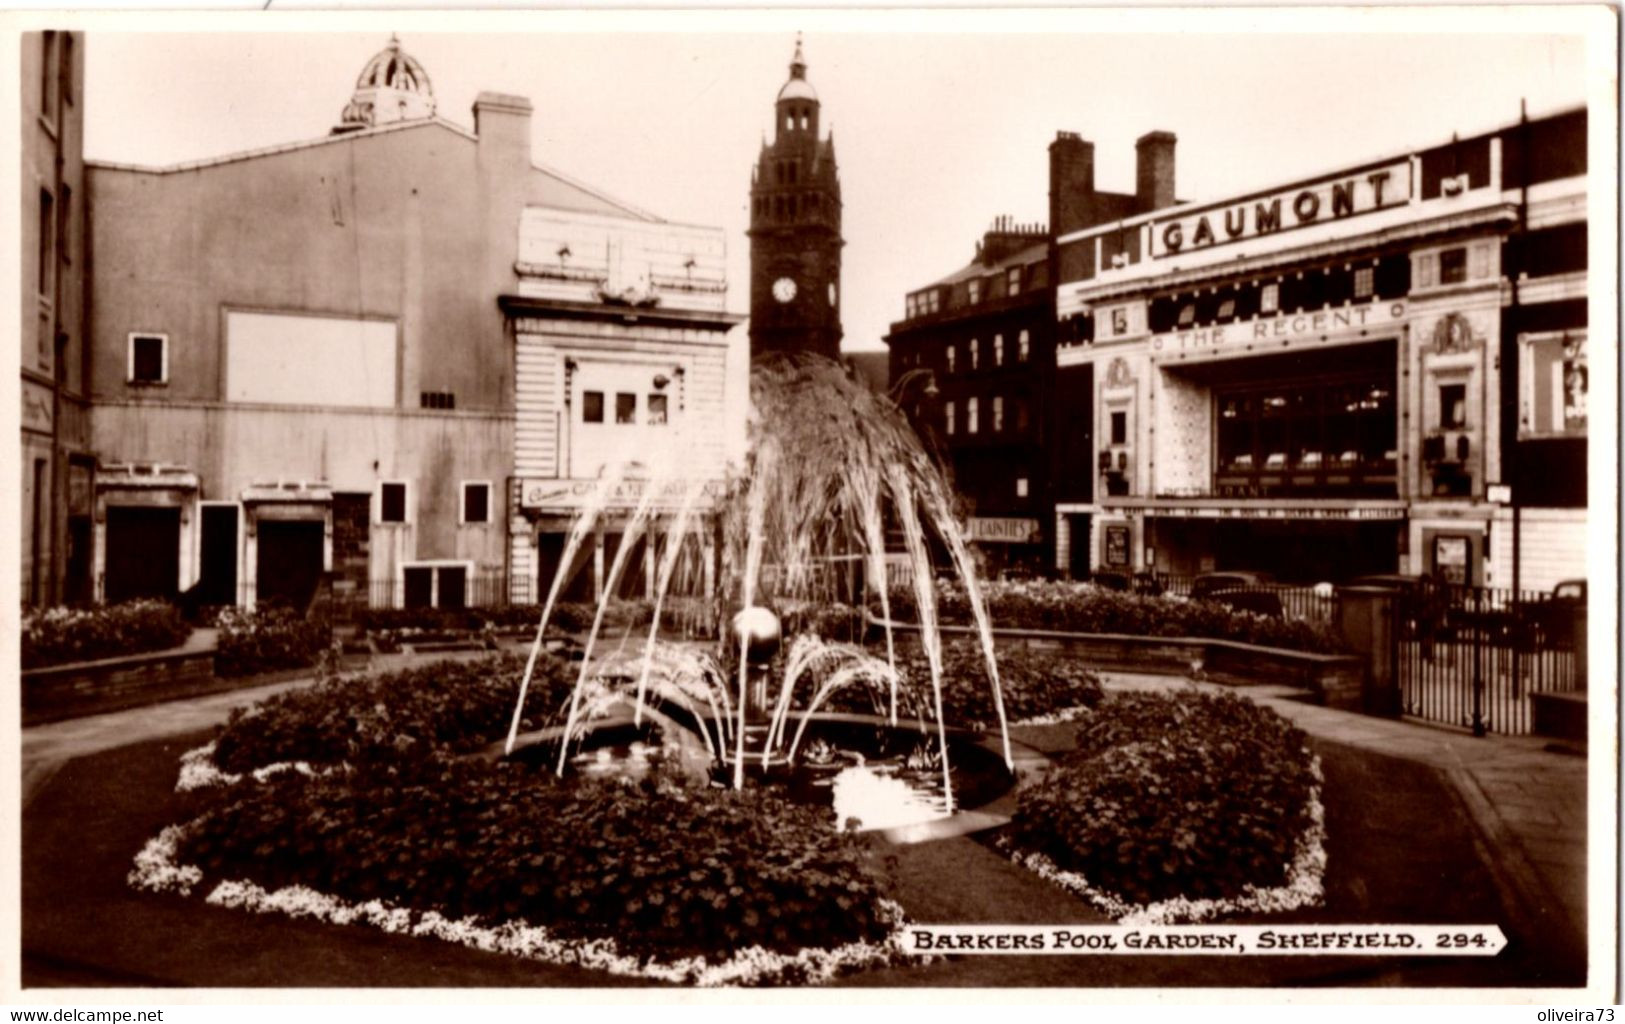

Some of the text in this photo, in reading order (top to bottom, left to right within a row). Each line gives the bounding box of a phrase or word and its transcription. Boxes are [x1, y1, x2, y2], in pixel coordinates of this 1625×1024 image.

[1162, 171, 1391, 253] GAUMONT
[1178, 306, 1373, 349] THE REGENT
[1164, 486, 1271, 497] RESTURANT
